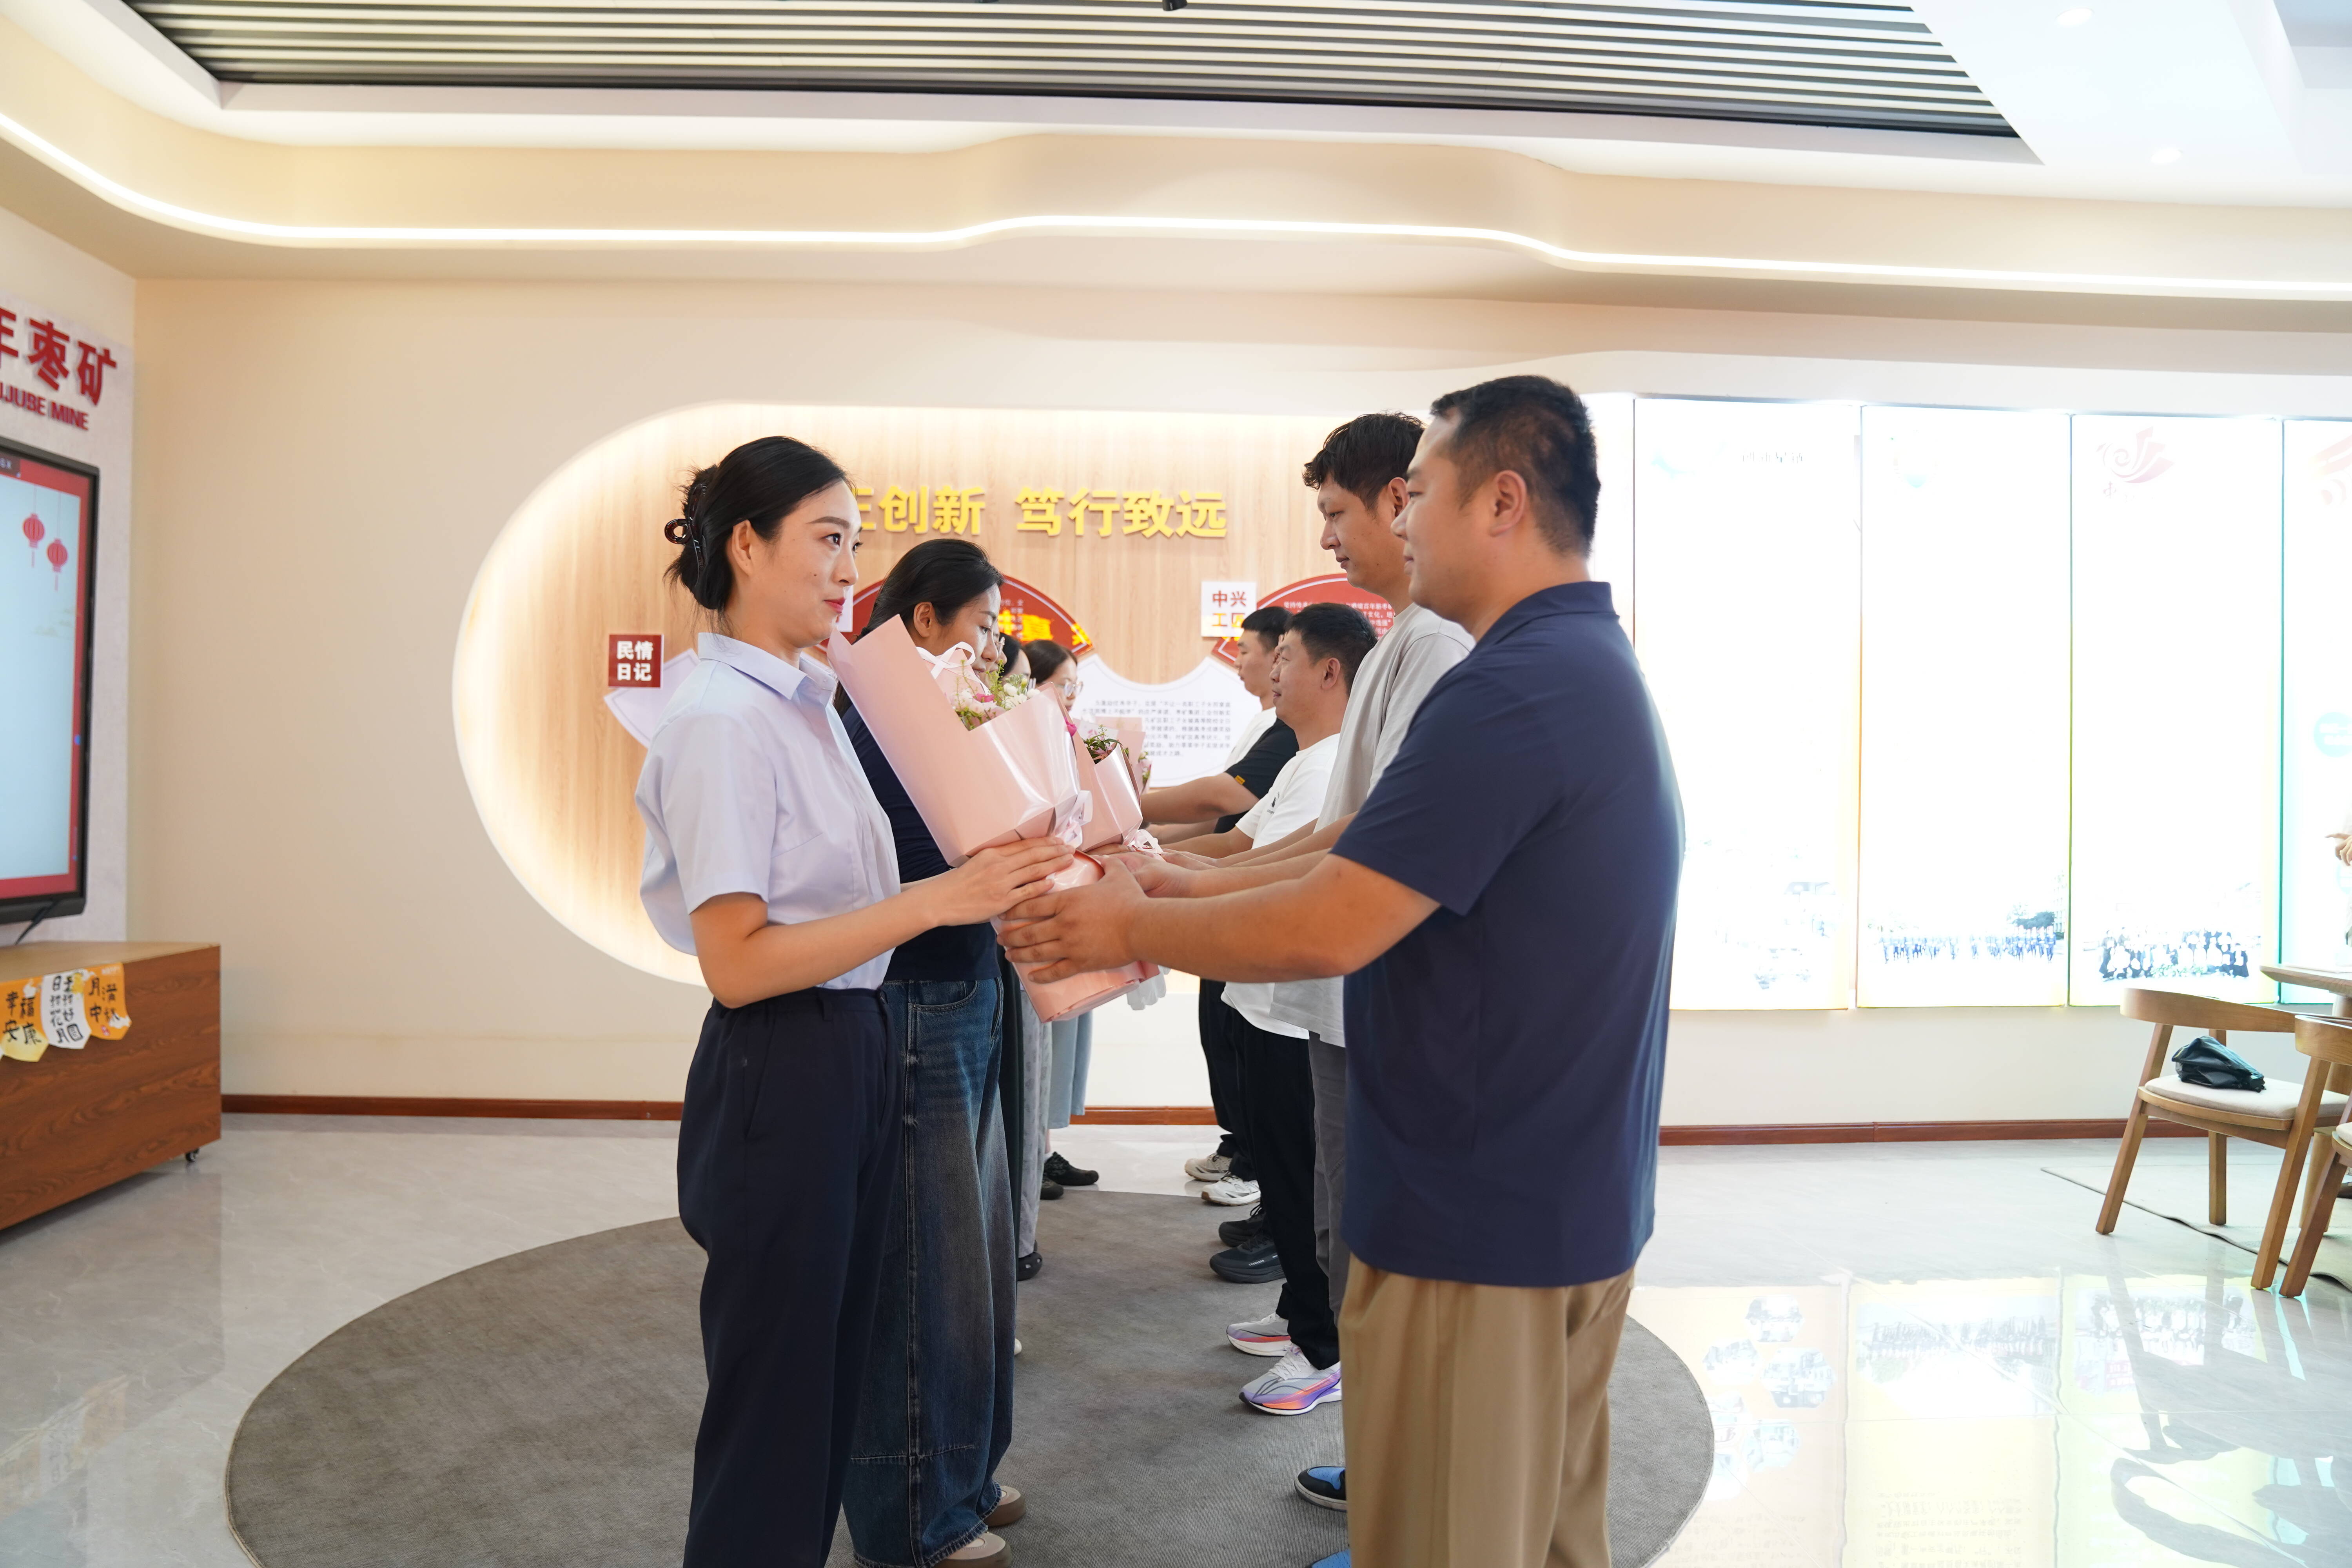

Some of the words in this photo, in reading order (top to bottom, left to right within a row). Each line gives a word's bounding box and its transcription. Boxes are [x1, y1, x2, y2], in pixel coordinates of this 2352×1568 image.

[51, 401, 89, 431] MINE
[1014, 486, 1227, 539] 笃行致远
[1212, 590, 1247, 607] 中兴
[617, 641, 653, 661] 民情
[617, 662, 652, 681] 日记
